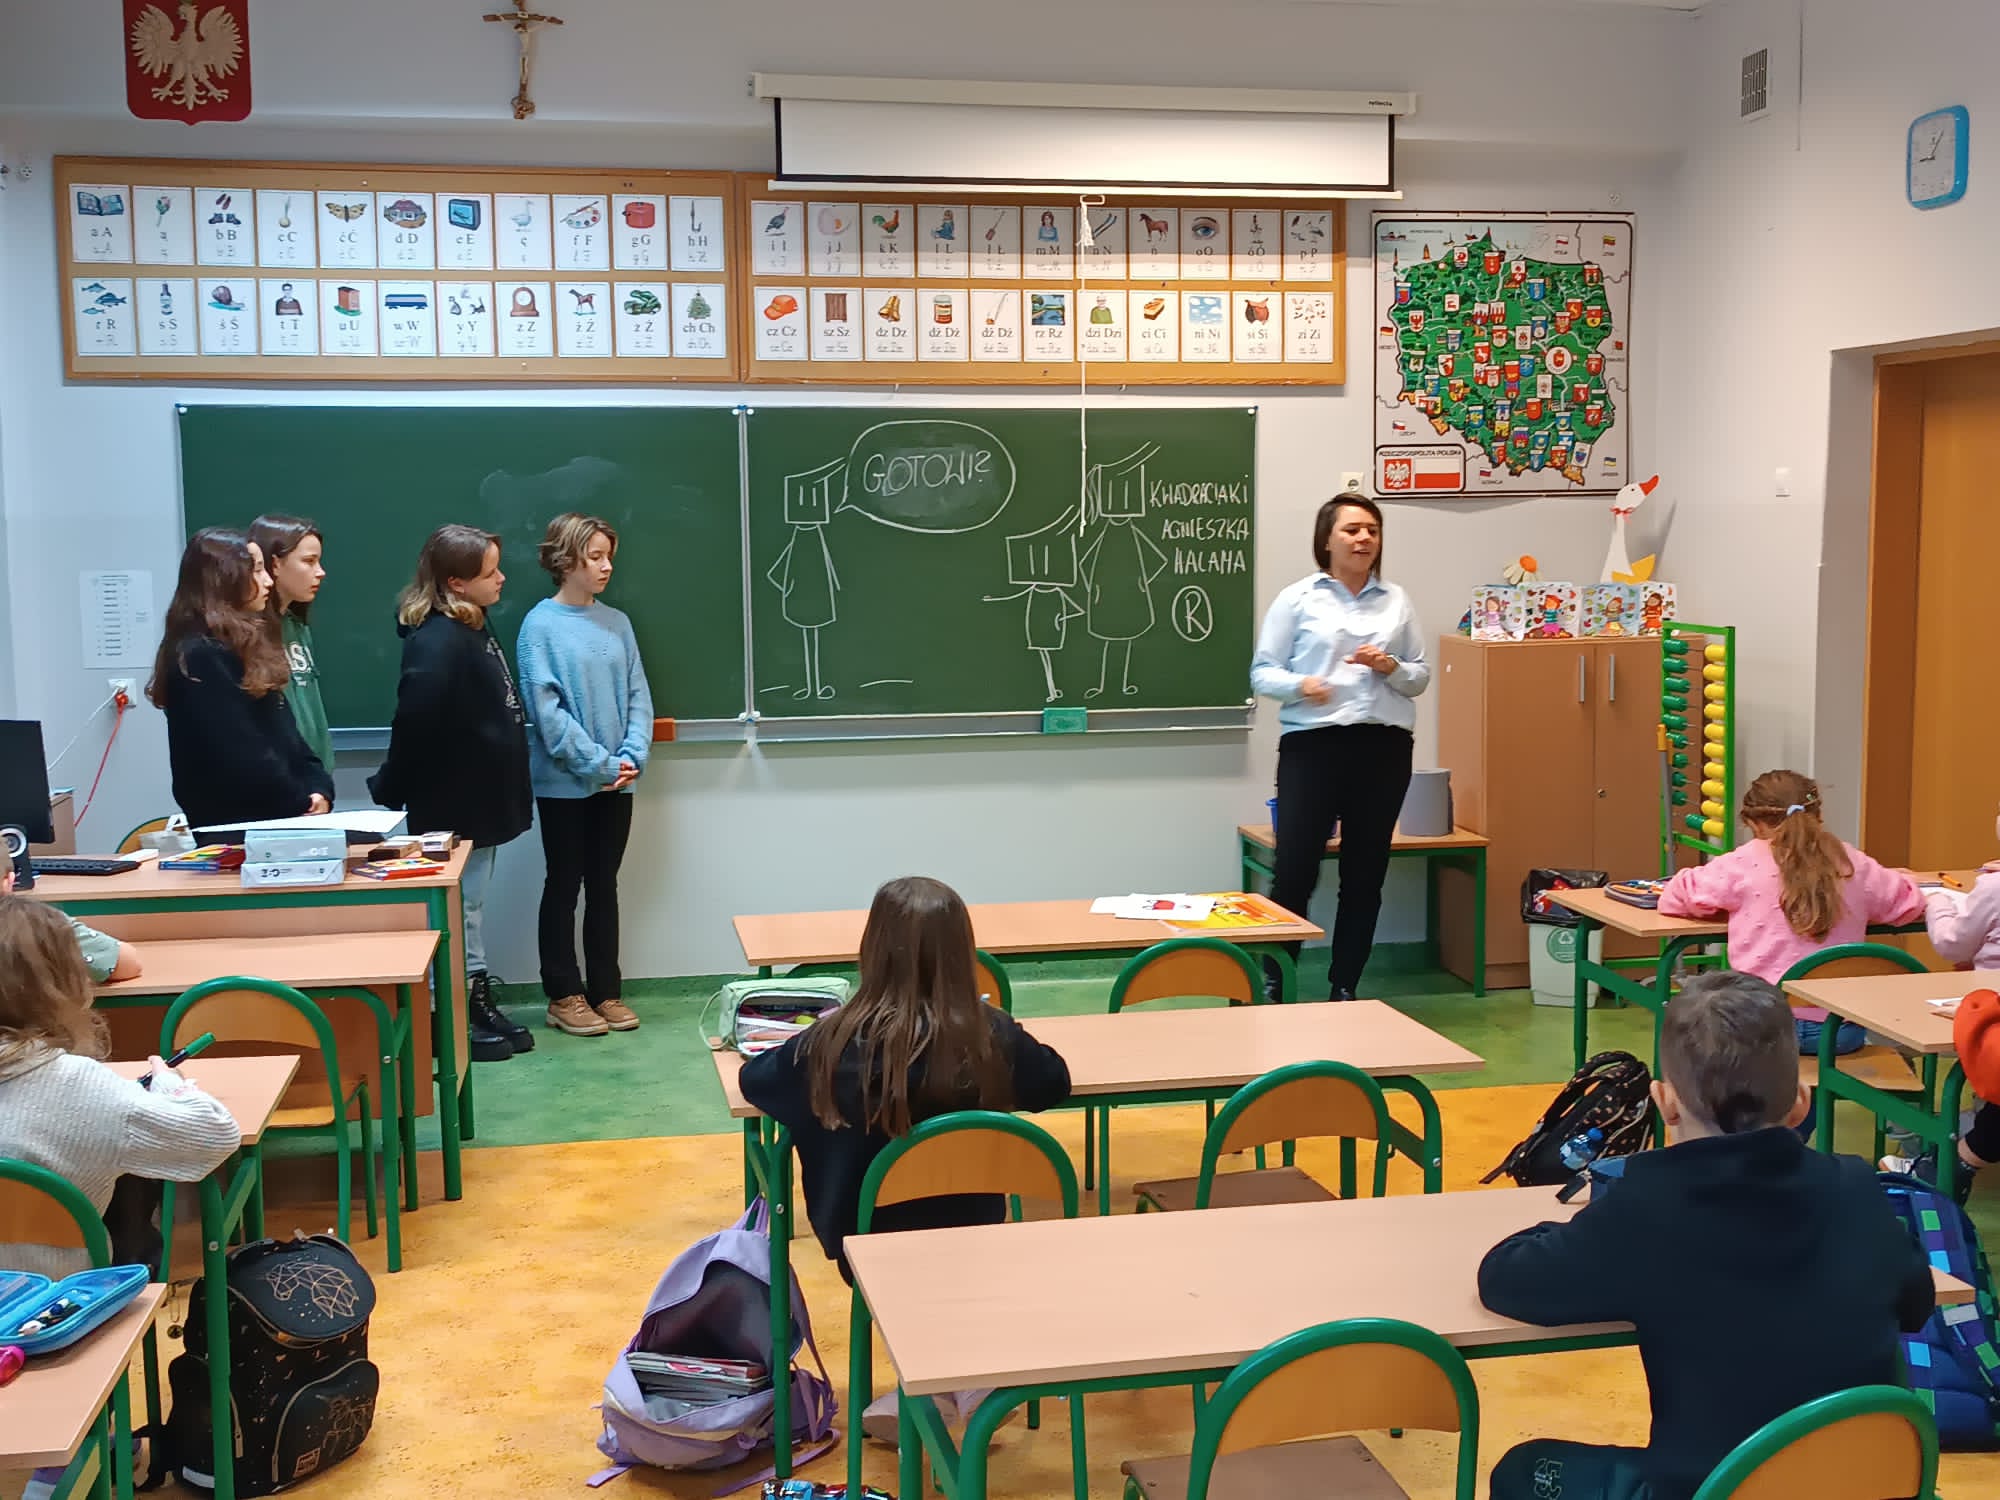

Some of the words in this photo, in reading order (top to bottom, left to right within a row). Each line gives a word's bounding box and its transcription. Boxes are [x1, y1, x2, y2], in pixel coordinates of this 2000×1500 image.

[102, 226, 112, 238] A
[216, 228, 224, 240] b
[227, 229, 237, 240] B
[287, 231, 298, 243] C
[395, 232, 403, 244] d
[407, 232, 418, 244] D
[466, 233, 476, 245] E
[632, 236, 639, 248] g
[640, 234, 651, 246] G
[687, 234, 695, 246] h
[698, 235, 708, 246] H
[889, 242, 899, 254] K
[1035, 247, 1046, 255] m
[1048, 246, 1060, 255] M
[1092, 247, 1100, 255] n
[1102, 245, 1112, 255] N
[1195, 248, 1203, 256] o
[1203, 246, 1214, 256] O
[106, 318, 117, 330] R
[169, 318, 178, 330] S
[349, 319, 359, 331] U
[406, 320, 420, 331] W
[467, 320, 477, 331] Y
[527, 321, 536, 332] Z
[682, 321, 696, 333] ch
[699, 321, 716, 333] Ch
[766, 328, 779, 336] cz
[781, 326, 798, 336] Cz
[824, 328, 835, 337] sz
[836, 326, 850, 337] Sz
[875, 327, 889, 337] dz
[892, 327, 908, 337] Dz
[1035, 330, 1045, 338] rz
[1048, 327, 1063, 338] Rz
[1085, 327, 1100, 338] dzi
[1103, 327, 1122, 338] Dzi
[1141, 329, 1151, 338] ci
[1153, 328, 1166, 338] Ci
[1194, 329, 1205, 339] ni
[1208, 328, 1221, 339] Ni
[1247, 330, 1256, 339] si
[1257, 328, 1268, 339] Si
[1298, 329, 1308, 340] zi
[1309, 328, 1321, 340] Zi
[863, 450, 992, 494] GOTOWI?
[1161, 517, 1249, 541] AGNIESZKA
